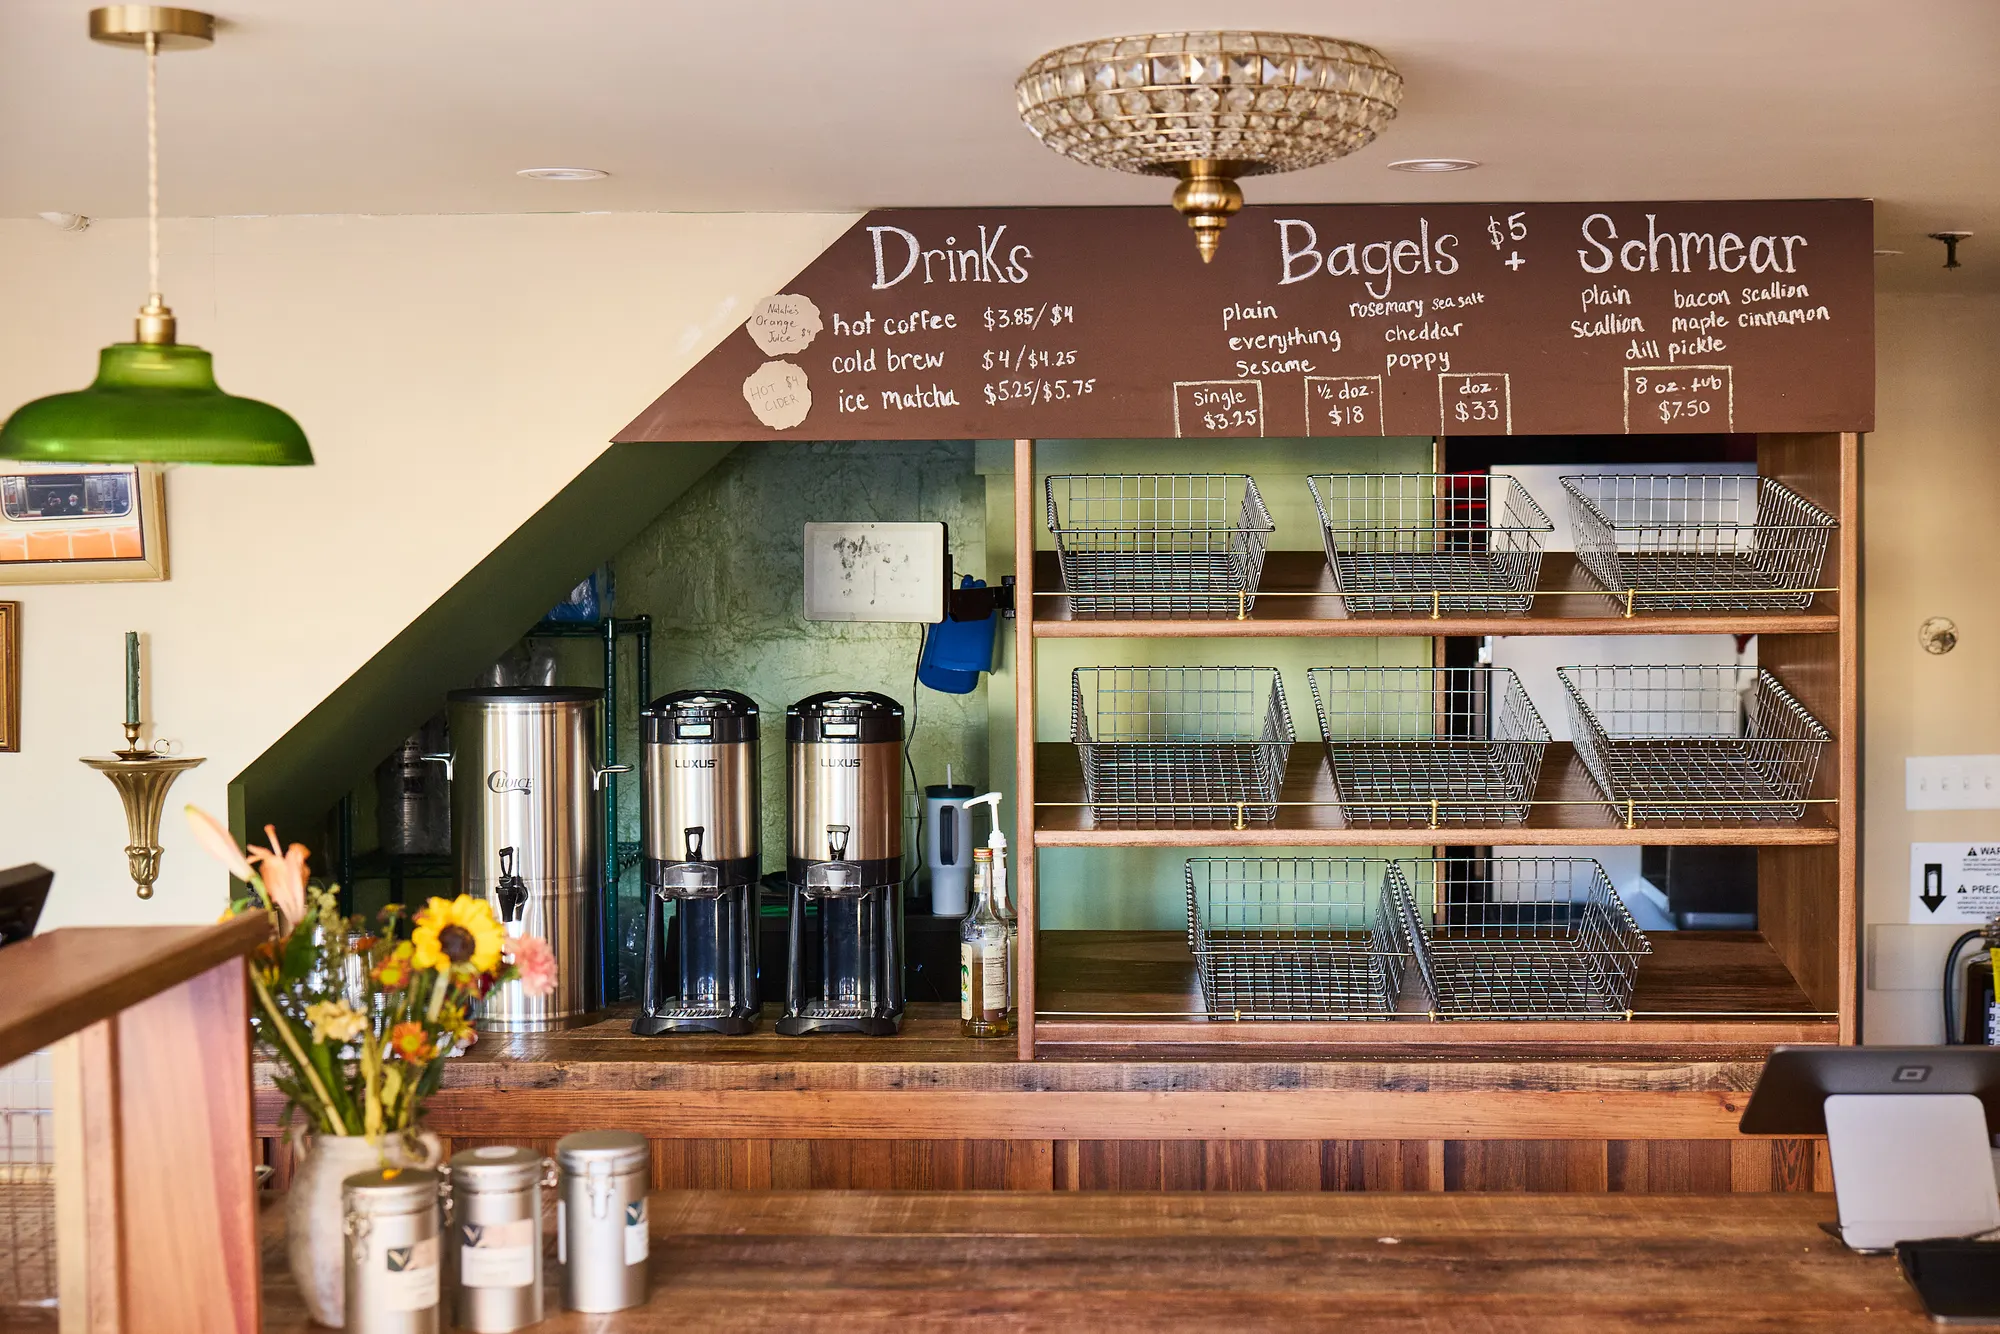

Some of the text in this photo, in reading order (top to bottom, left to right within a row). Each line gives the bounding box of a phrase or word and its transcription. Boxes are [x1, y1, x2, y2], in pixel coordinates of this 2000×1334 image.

[1488, 212, 1526, 250] $5
[1577, 214, 1807, 273] Schmear
[1274, 218, 1460, 300] Bagels
[768, 304, 800, 314] Natalie's
[1582, 281, 1809, 313] plain bacon scallion
[833, 311, 876, 335] hot
[884, 310, 957, 335] coffee
[1223, 292, 1484, 331] plain rosemary sea salt
[1571, 306, 1830, 338] scallion maple cinnamon
[756, 315, 798, 334] Orange
[768, 328, 811, 343] Juice $4
[1229, 321, 1462, 354] everything cheddar
[1626, 336, 1726, 362] dill pickle
[833, 348, 876, 373] cold
[887, 348, 944, 372] brew
[1236, 352, 1452, 379] sesame poppy
[750, 376, 799, 400] HOT $4
[839, 379, 1096, 412] ice matcha $5.25/$5.75
[1339, 382, 1373, 399] doz.
[1460, 378, 1497, 394] doz.
[1636, 375, 1721, 394] 8 oz. tub
[765, 394, 800, 412] CIDER
[1194, 388, 1247, 412] single
[1455, 400, 1498, 422] $33
[1659, 400, 1710, 424] $7.50
[1328, 405, 1364, 426] $18
[675, 760, 717, 768] LUXUS
[820, 758, 862, 768] LUXUS
[1972, 885, 2000, 894] PREC
